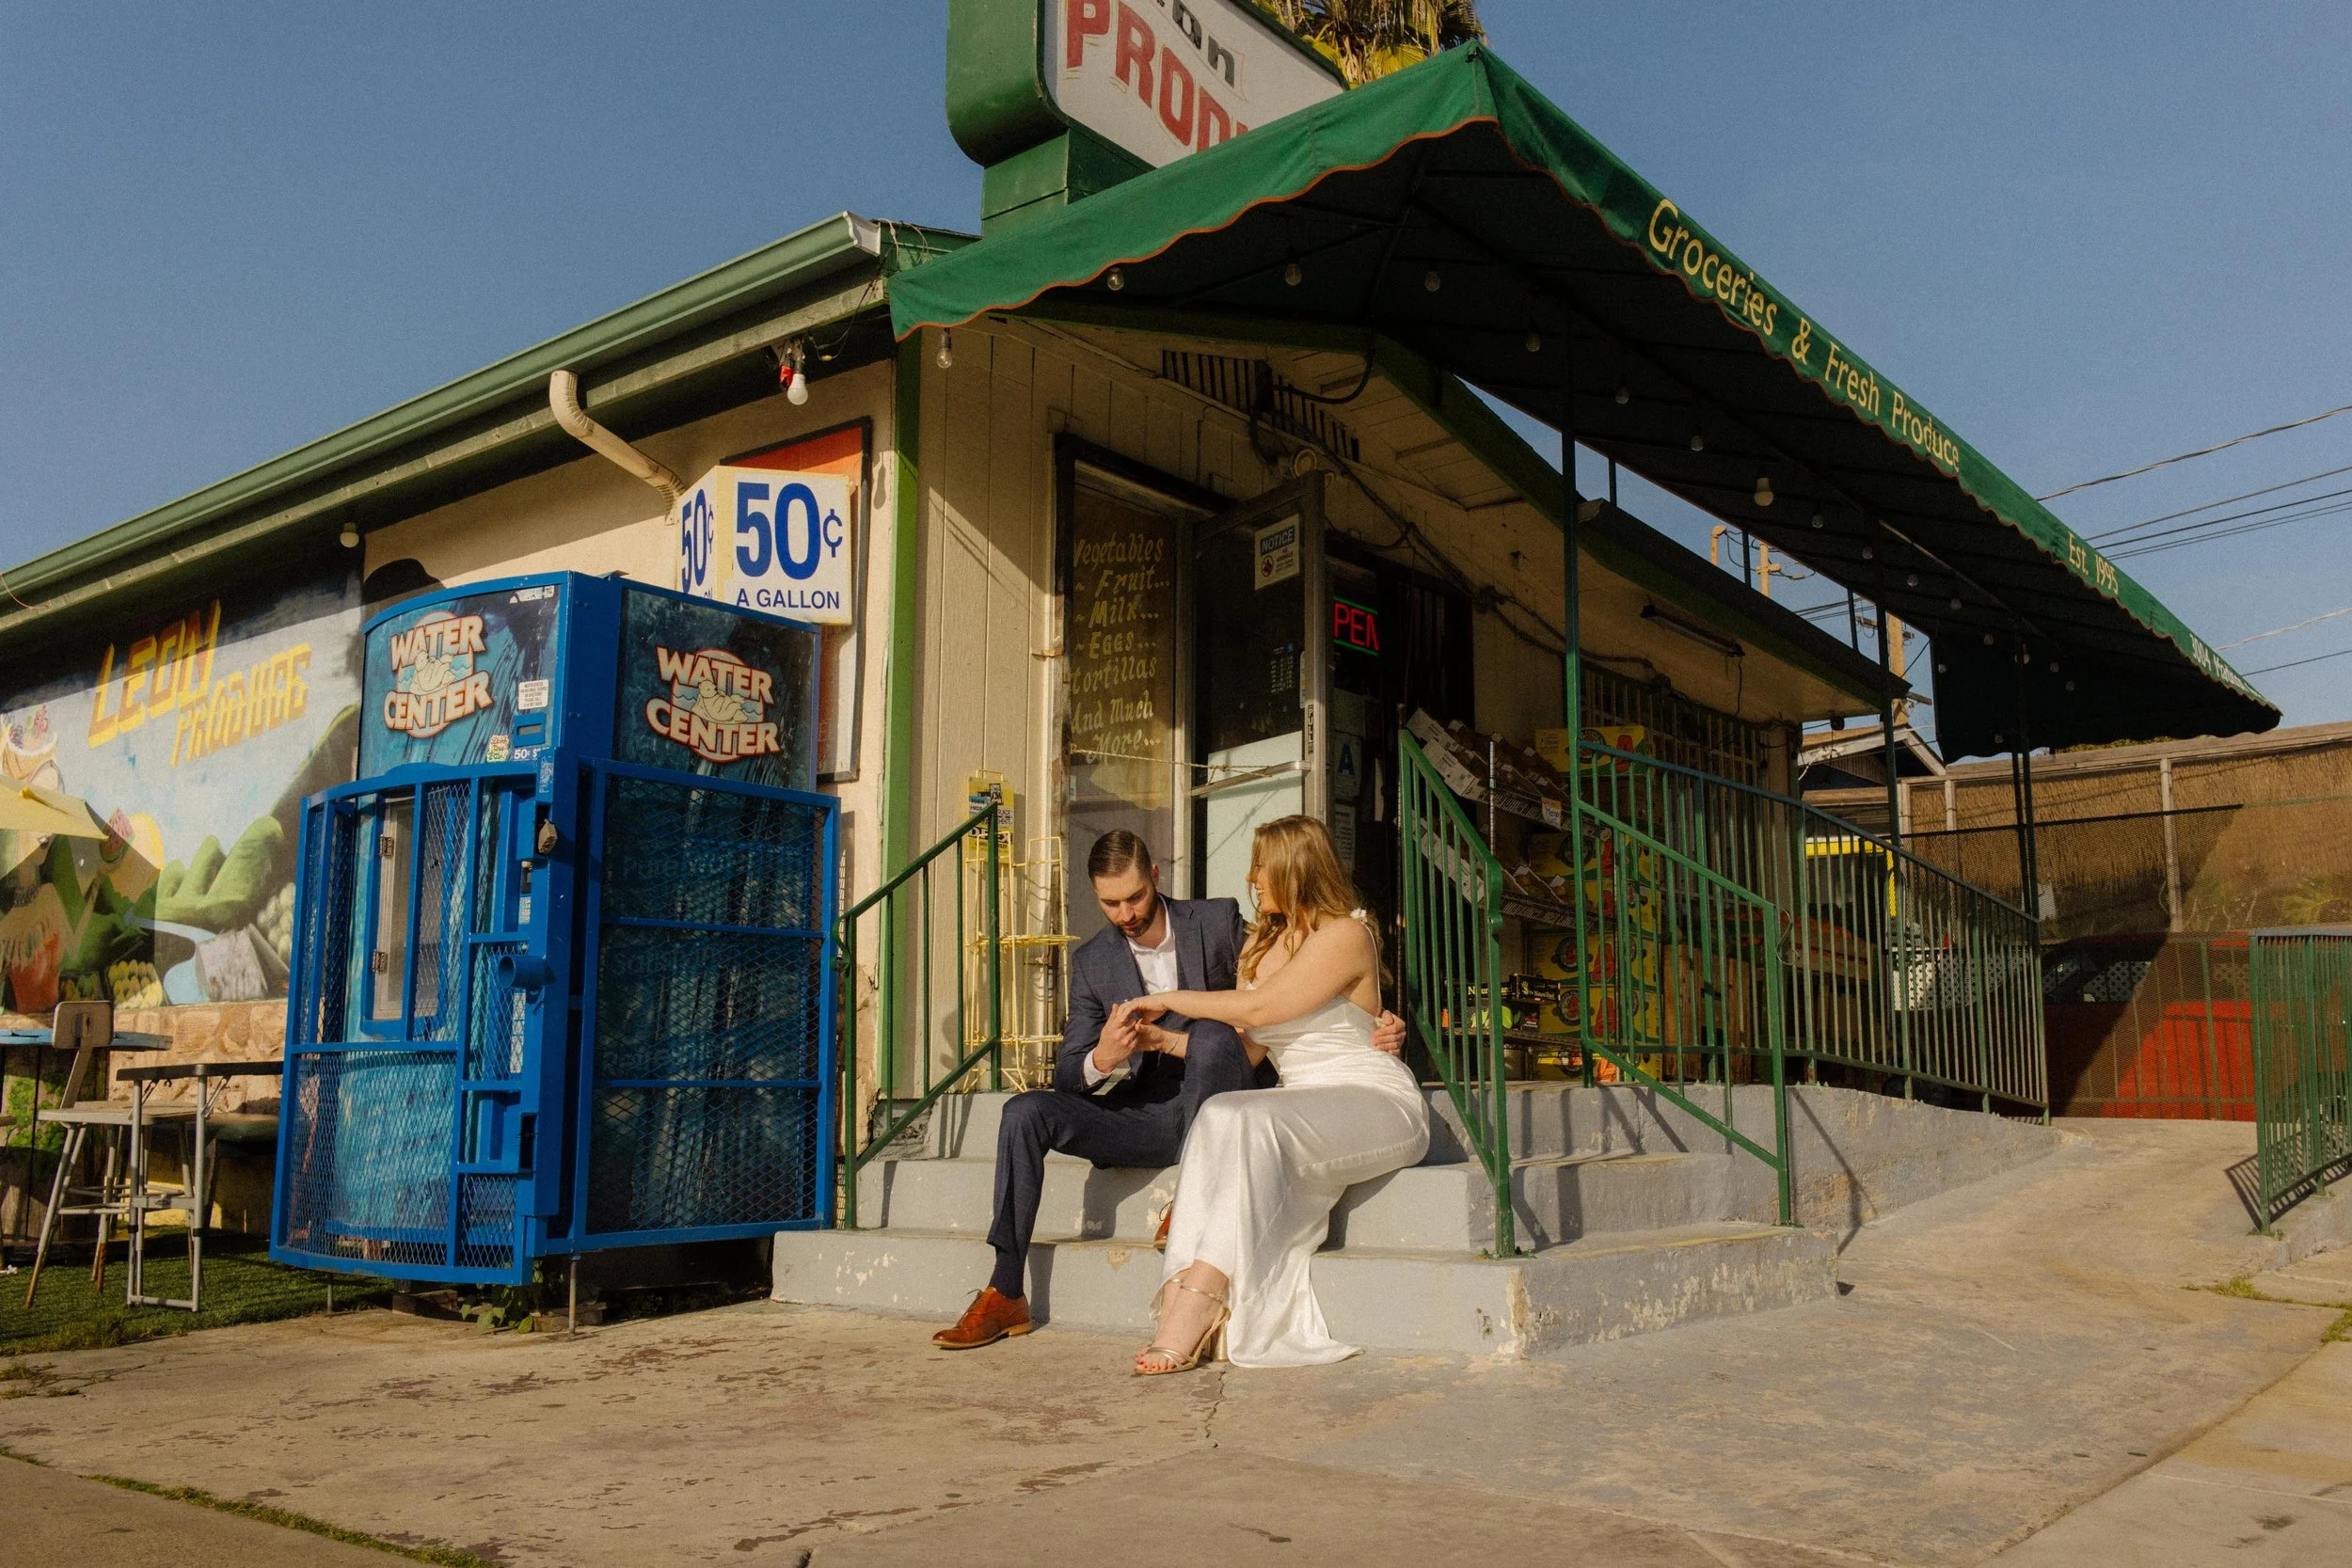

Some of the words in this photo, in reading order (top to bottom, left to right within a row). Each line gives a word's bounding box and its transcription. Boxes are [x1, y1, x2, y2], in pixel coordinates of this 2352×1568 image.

[1156, 0, 1234, 87] on
[1067, 0, 1248, 152] PROD
[1649, 198, 1777, 336] Groceries
[1791, 317, 1811, 365] &
[1825, 341, 1880, 417] Fresh
[1892, 390, 1959, 472] Produce
[682, 489, 714, 593] 50¢
[736, 482, 843, 580] 50¢
[1073, 531, 1165, 572] Vegetables
[1262, 529, 1294, 553] NOTICE
[2068, 531, 2089, 575] Est.
[2095, 554, 2119, 594] 1995
[737, 588, 750, 607] A
[756, 589, 839, 609] GALLON
[1334, 603, 1380, 651] PEN
[390, 615, 486, 672] WATER
[87, 598, 221, 749] LEON
[384, 670, 492, 730] CENTER
[656, 646, 775, 705] WATER
[645, 698, 781, 755] CENTER
[1071, 699, 1104, 734] And
[1109, 689, 1154, 725] Much
[1338, 744, 1355, 775] A
